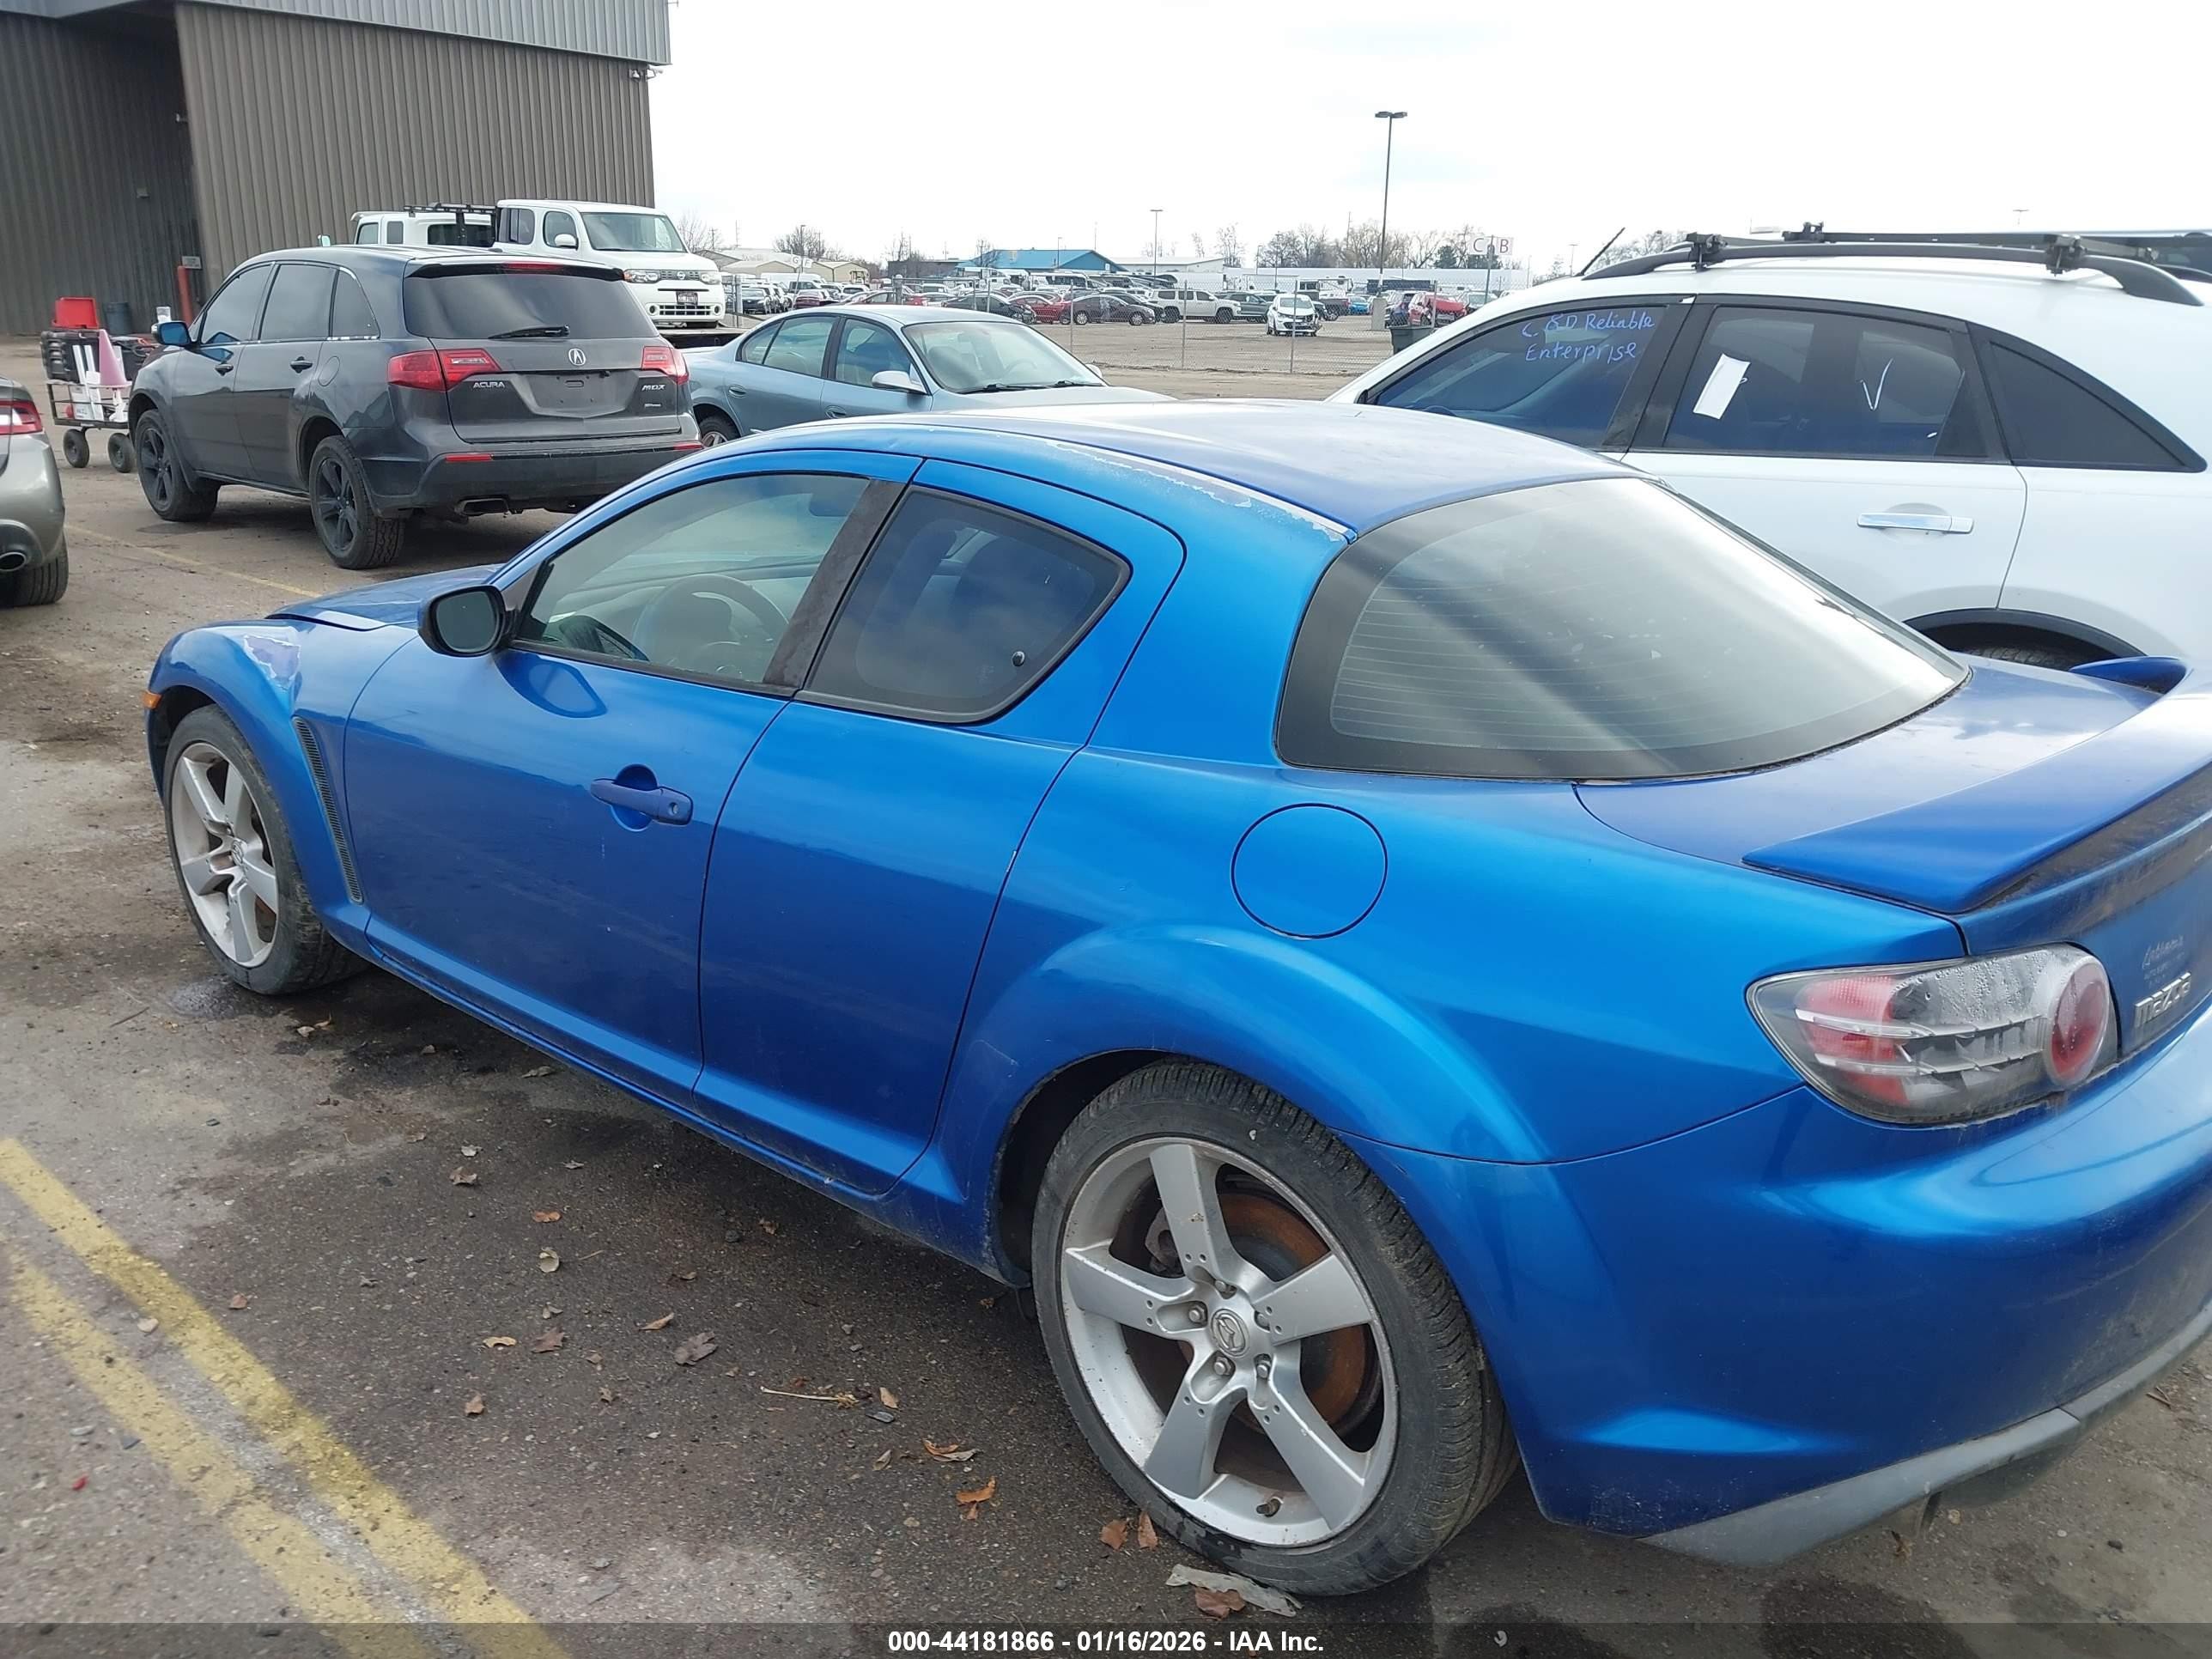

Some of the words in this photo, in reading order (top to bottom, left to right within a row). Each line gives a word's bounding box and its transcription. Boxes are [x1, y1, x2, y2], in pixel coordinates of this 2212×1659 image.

[1473, 238, 1485, 252] C
[1499, 239, 1510, 253] B
[1585, 310, 1656, 331] Reliable
[1525, 342, 1638, 364] Enterprise
